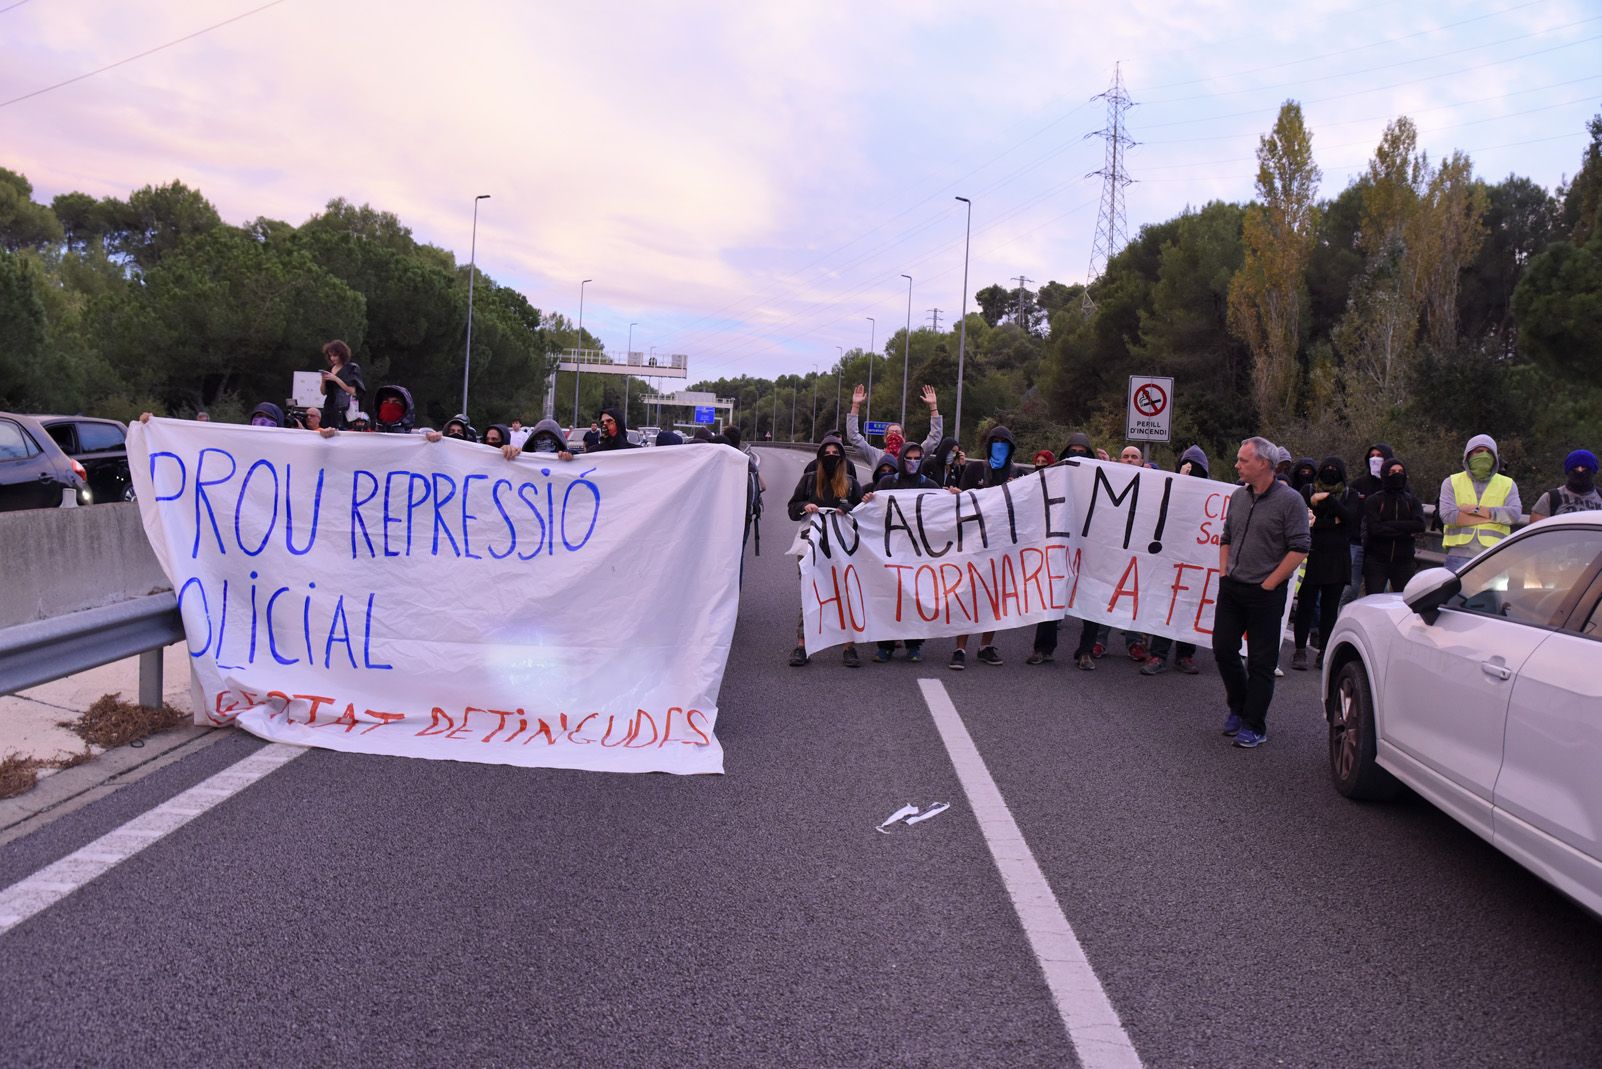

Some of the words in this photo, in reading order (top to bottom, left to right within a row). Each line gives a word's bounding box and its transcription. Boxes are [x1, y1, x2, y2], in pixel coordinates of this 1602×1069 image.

[1130, 427, 1167, 436] D'INCENDI
[1136, 420, 1161, 428] PERILL
[149, 448, 325, 559] PROU
[177, 570, 393, 671] OLICIAL
[813, 564, 866, 635] HO
[884, 544, 1082, 625] TORNAREM
[1107, 556, 1139, 621] A
[1165, 562, 1220, 636] FE
